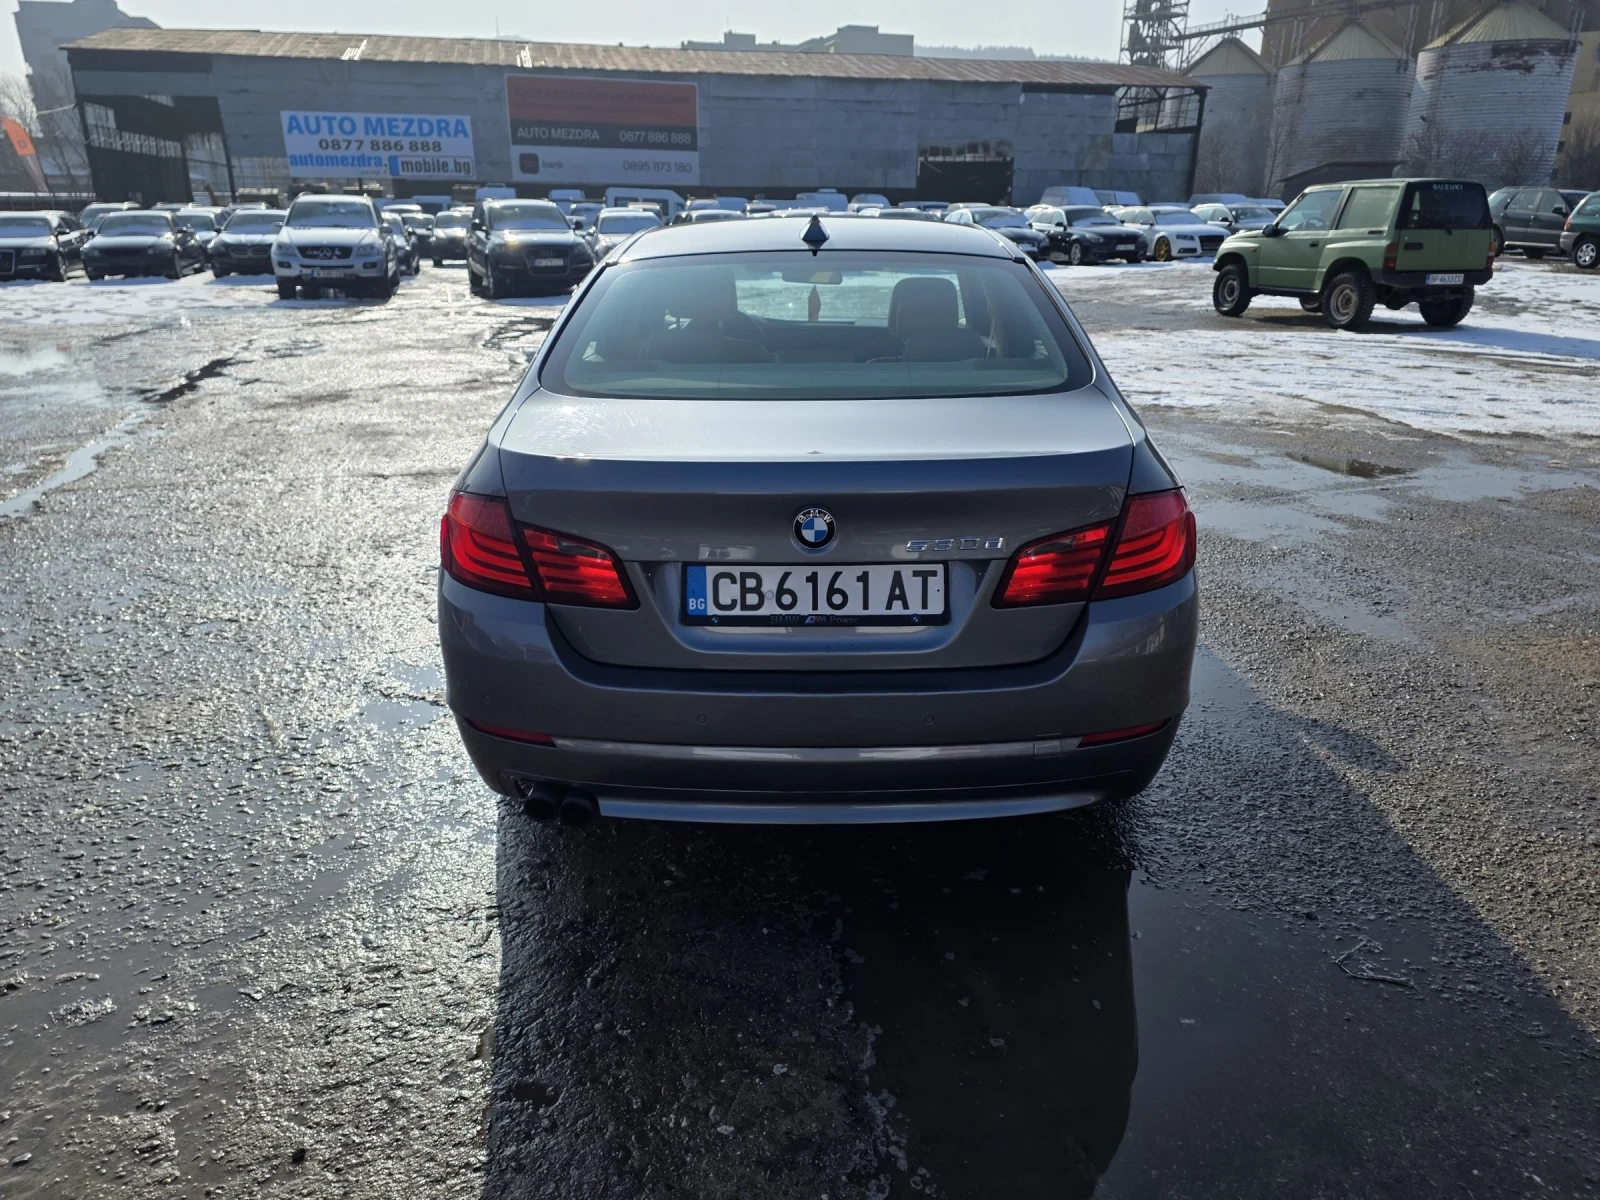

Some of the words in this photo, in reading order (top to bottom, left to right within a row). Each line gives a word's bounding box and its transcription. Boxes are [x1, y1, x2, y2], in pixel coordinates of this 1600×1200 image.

[287, 114, 357, 136] AUTO
[364, 116, 470, 138] MEZDRA
[517, 127, 549, 139] AUTO
[551, 128, 600, 141] MEZDRA
[619, 130, 646, 143] 0877
[648, 131, 669, 144] 886
[670, 132, 692, 145] 888
[318, 139, 365, 151] 0877
[370, 139, 404, 152] 886
[409, 140, 442, 152] 888
[401, 157, 471, 175] mobile.bg
[542, 159, 564, 169] bank
[622, 160, 650, 172] 0895
[653, 161, 672, 173] 873
[798, 509, 833, 523] BMW
[712, 571, 763, 612] CB
[775, 570, 871, 612] 6161
[885, 570, 938, 611] AT
[688, 598, 705, 610] BG
[770, 614, 800, 625] BMW
[829, 614, 858, 625] Power
